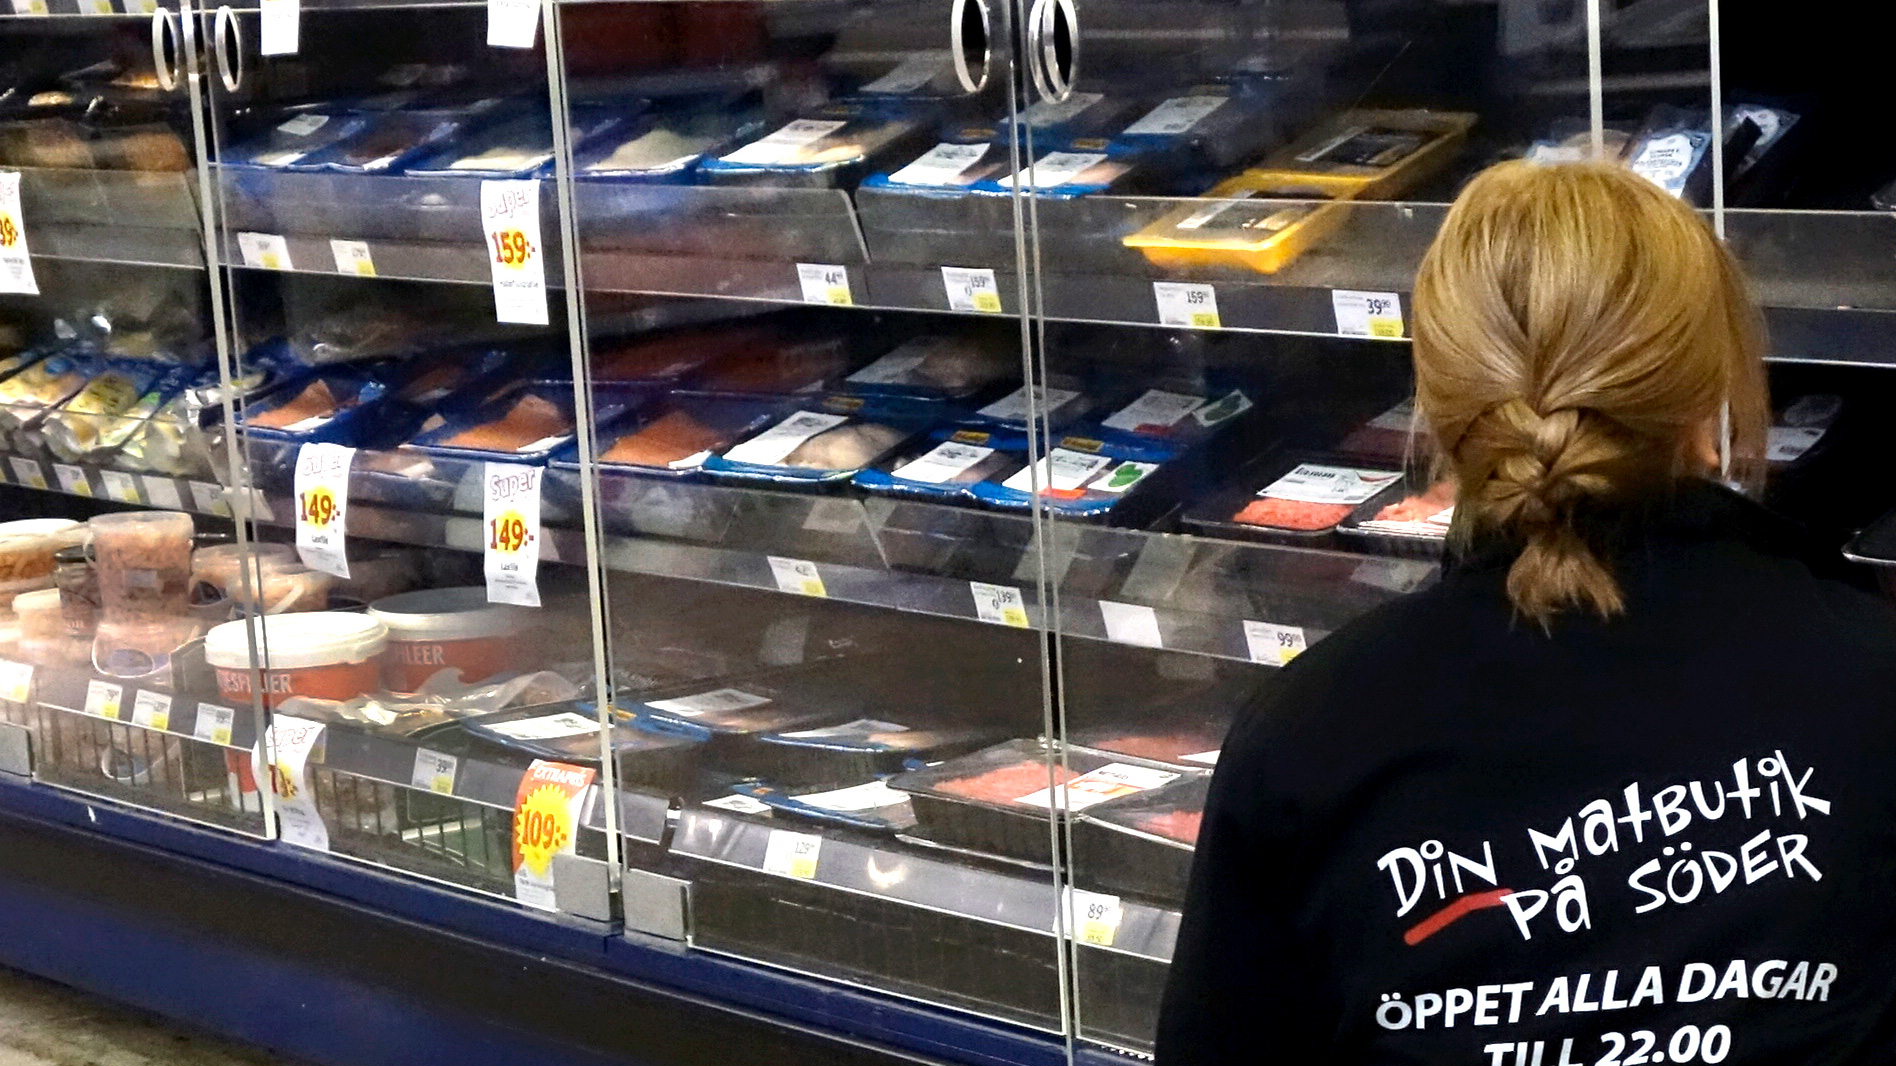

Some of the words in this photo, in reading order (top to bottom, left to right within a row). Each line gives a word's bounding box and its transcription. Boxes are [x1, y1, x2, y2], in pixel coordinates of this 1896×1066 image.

[491, 230, 536, 264] 159:-
[490, 470, 536, 503] Super
[300, 492, 340, 526] 149:-
[490, 518, 534, 552] 149:-
[521, 809, 568, 850] 109:-
[1627, 829, 1823, 914] SÖDER
[1375, 982, 1534, 1030] ÖPPET
[1534, 965, 1664, 1017] ALLA
[1676, 959, 1838, 1003] DAGAR
